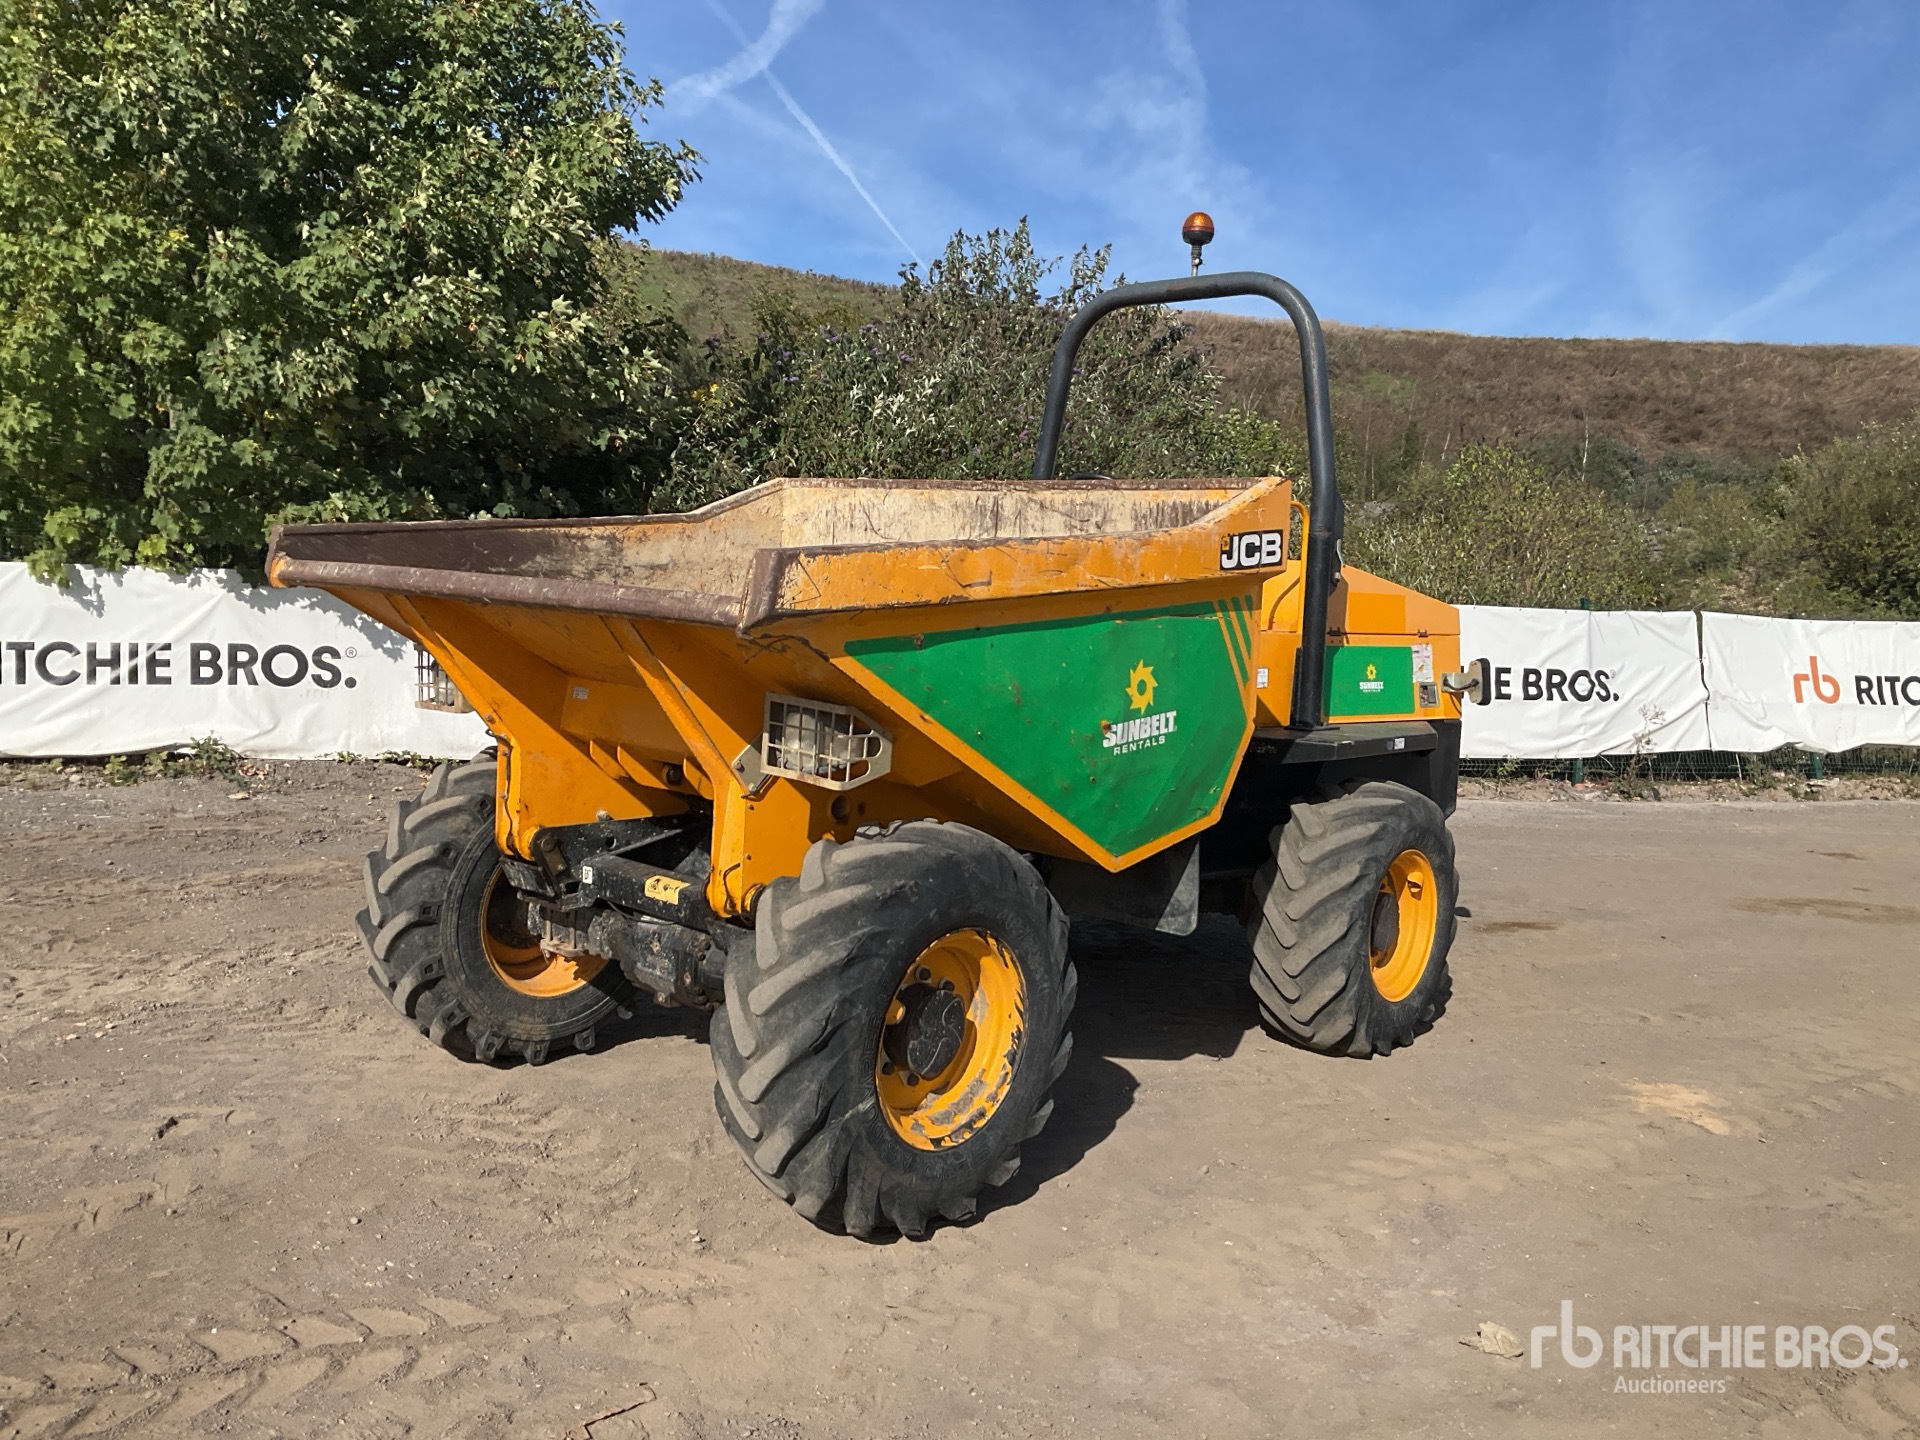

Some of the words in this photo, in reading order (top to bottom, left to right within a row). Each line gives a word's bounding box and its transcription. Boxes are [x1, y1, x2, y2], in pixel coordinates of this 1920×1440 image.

[1221, 532, 1282, 569] JCB
[0, 641, 172, 686] TCHIE
[1855, 675, 1920, 706] RITC
[1102, 710, 1177, 748] SUNBELT
[1113, 735, 1166, 756] RENTALS
